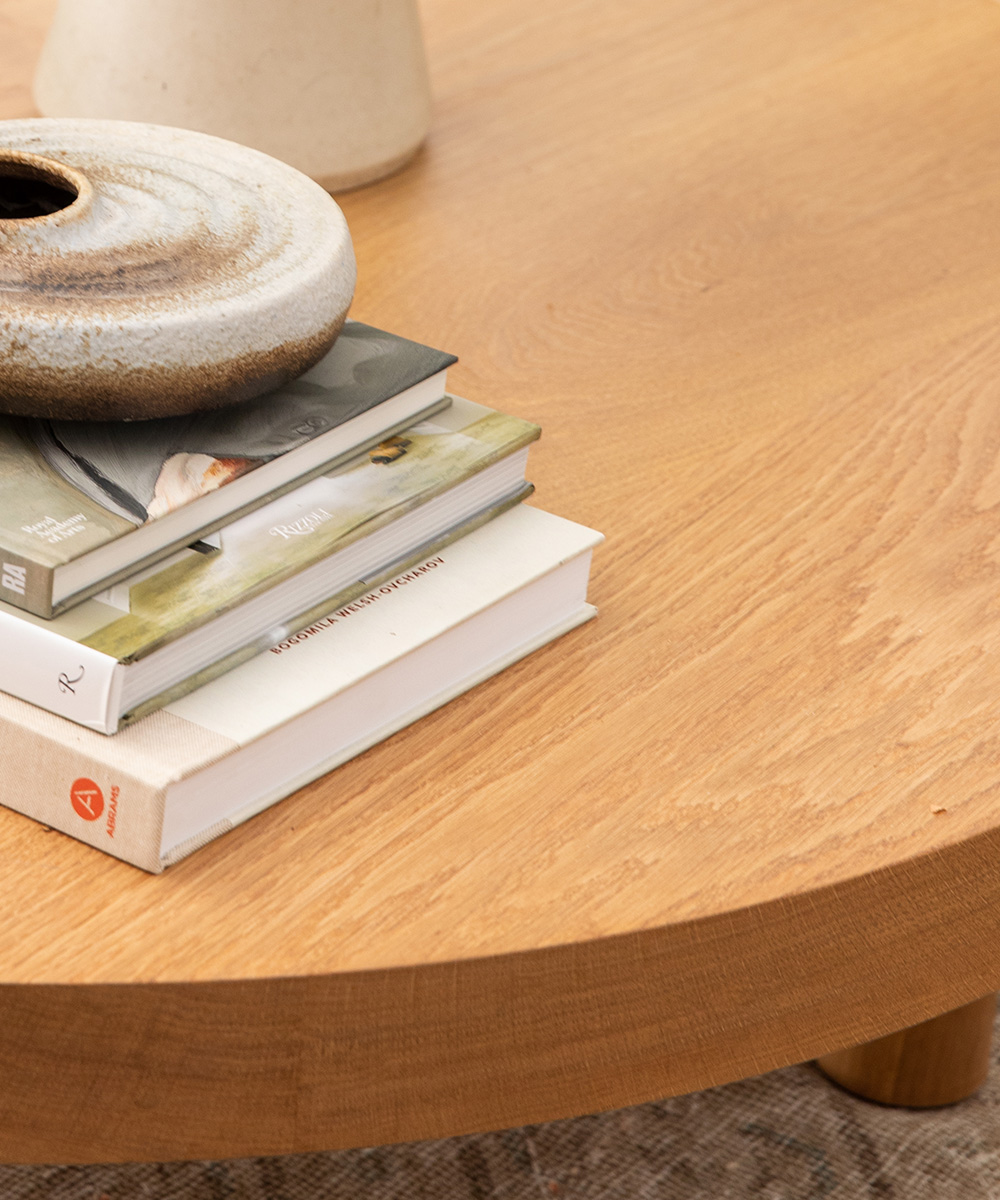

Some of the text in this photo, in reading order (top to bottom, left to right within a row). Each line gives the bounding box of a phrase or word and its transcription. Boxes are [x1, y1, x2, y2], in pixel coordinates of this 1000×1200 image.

[1, 562, 27, 596] RA
[269, 556, 446, 655] BOGOMILA WELSH-OVCHAROV
[58, 664, 85, 695] R
[105, 784, 121, 839] ABRAMS
